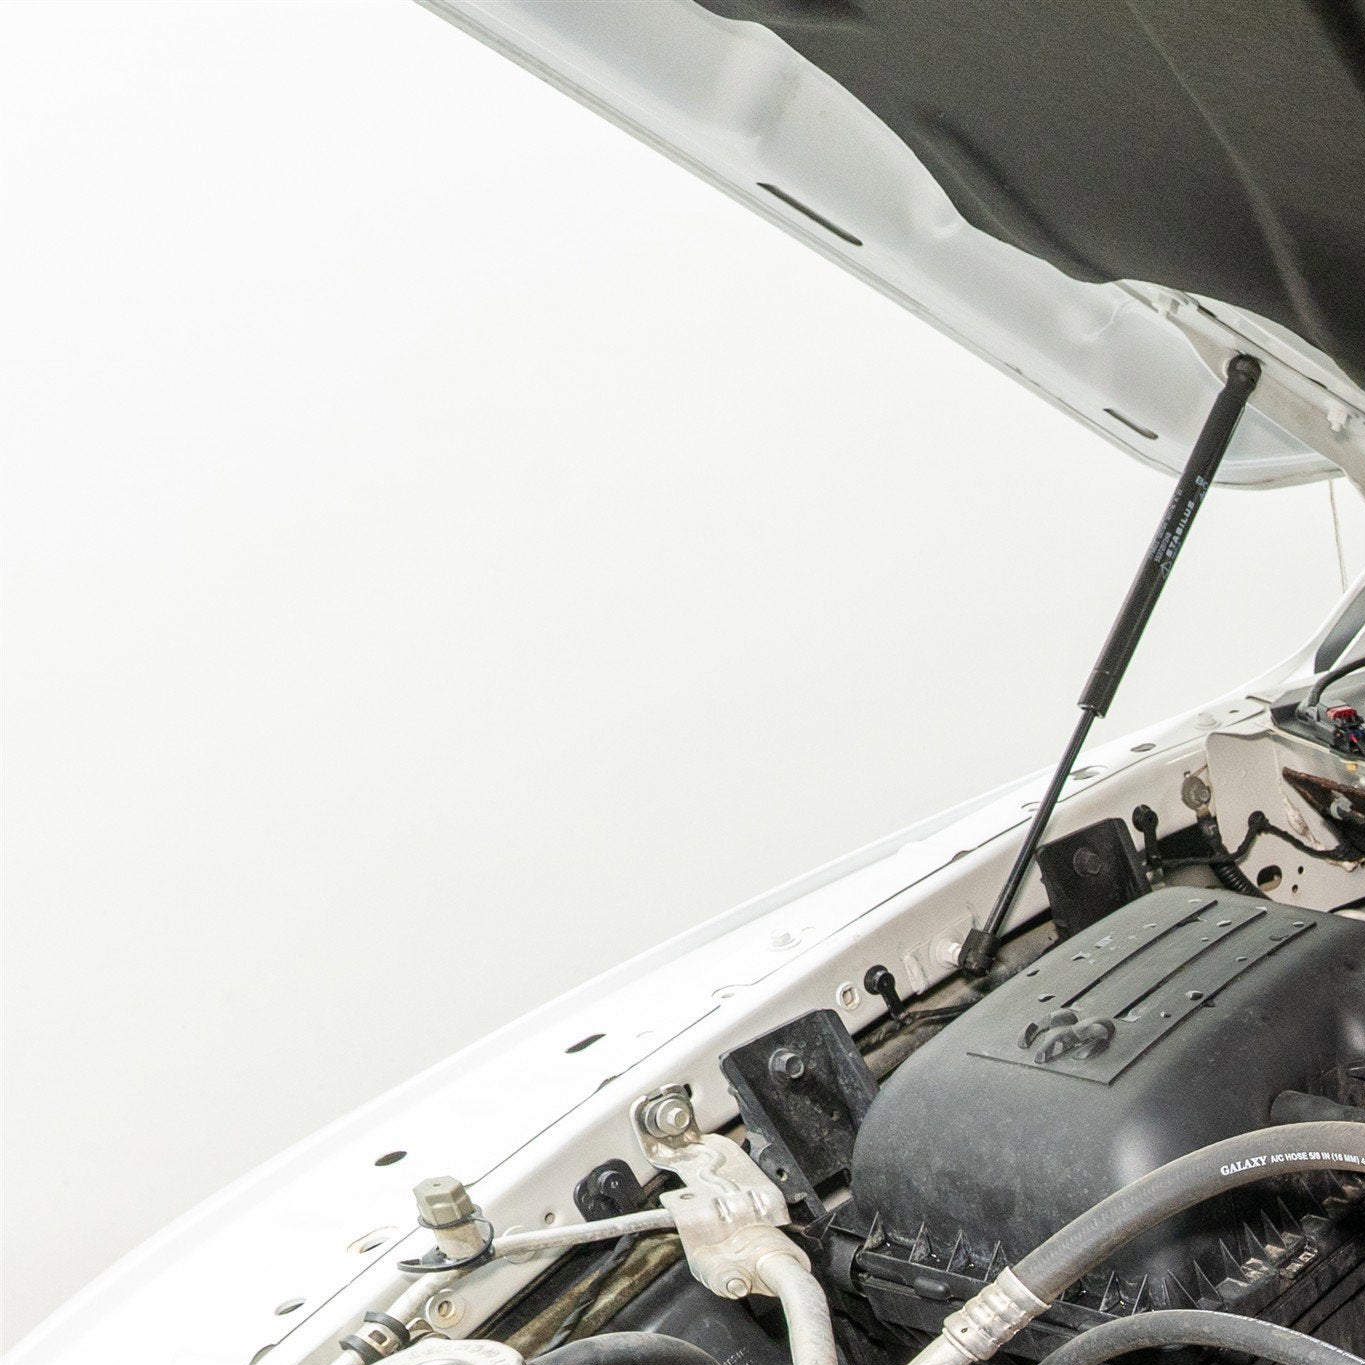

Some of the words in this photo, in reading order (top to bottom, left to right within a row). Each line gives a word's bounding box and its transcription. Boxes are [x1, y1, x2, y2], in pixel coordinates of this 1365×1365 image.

[1221, 1156, 1268, 1176] GALAXY
[1271, 1154, 1284, 1164] A/C
[1286, 1152, 1308, 1161] HOSE
[1322, 1151, 1330, 1161] IN
[1344, 1154, 1359, 1165] MM)
